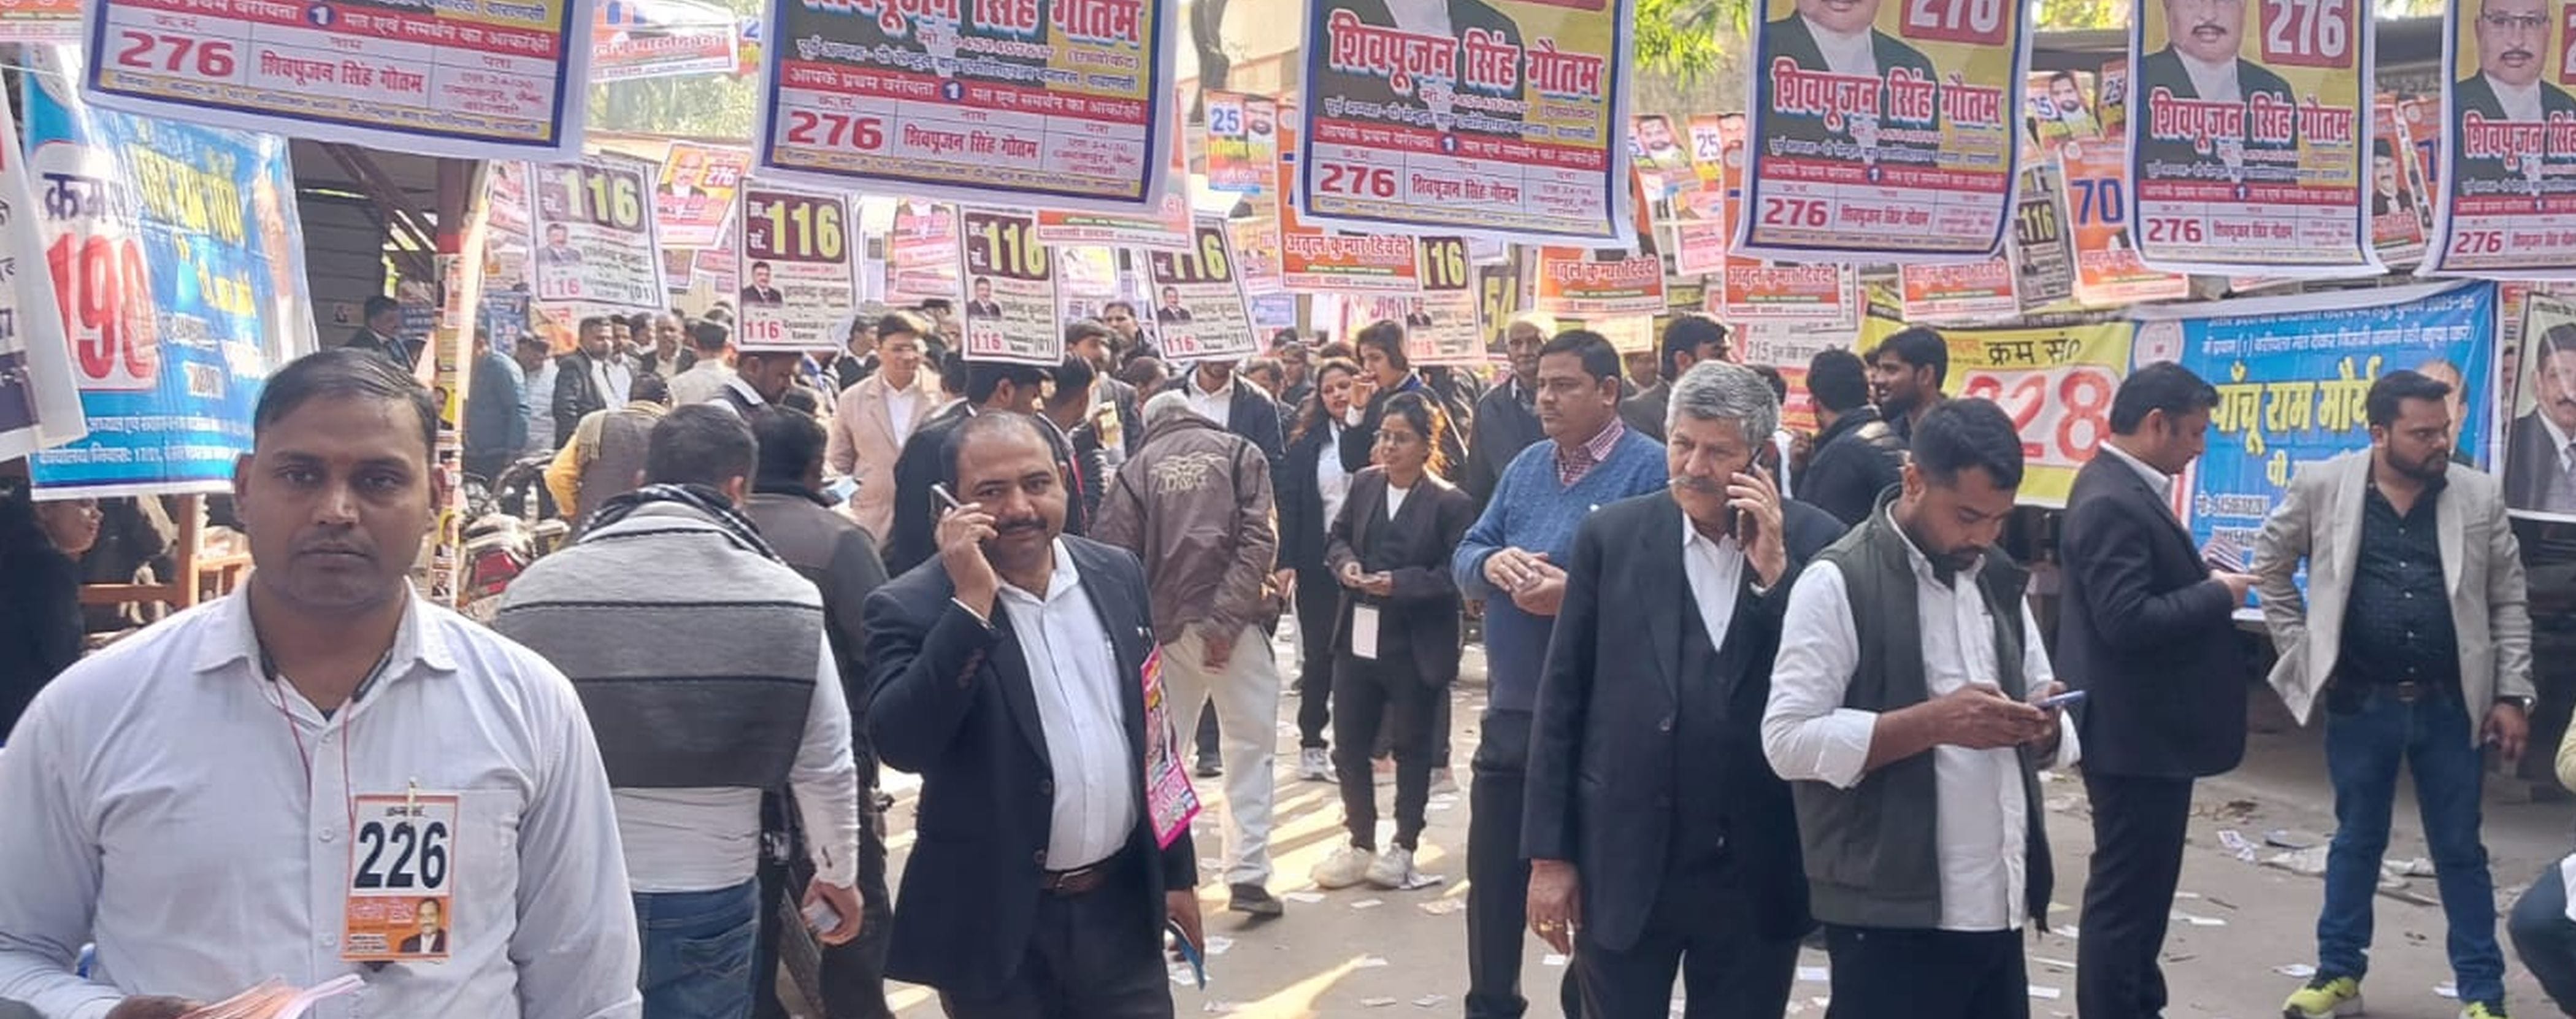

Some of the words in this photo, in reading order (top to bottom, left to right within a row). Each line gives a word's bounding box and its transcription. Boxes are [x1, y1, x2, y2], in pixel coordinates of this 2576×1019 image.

[314, 7, 328, 24] 1
[345, 13, 368, 27] मत
[403, 19, 456, 39] समर्थन
[460, 27, 483, 42] का
[2269, 0, 2346, 58] 276
[118, 31, 234, 77] 276
[261, 50, 334, 85] शिवपूजन
[342, 61, 372, 87] सिंह
[381, 66, 424, 93] गौतम
[1328, 10, 1458, 93] शिवपूजन
[1464, 29, 1519, 88] सिंह
[1526, 38, 1603, 96] गौतम
[791, 66, 837, 85] आपके
[842, 72, 879, 88] प्रथम
[883, 74, 935, 96] वरीयता
[946, 83, 959, 99] 1
[972, 87, 991, 101] मत
[996, 88, 1018, 106] एवं
[1021, 91, 1063, 110] समर्थन
[1066, 98, 1086, 112] का
[1772, 57, 1883, 131] शिवपूजन
[1887, 66, 1934, 121] सिंह
[1940, 73, 2004, 124] गौतम
[788, 110, 883, 150] 276
[1211, 107, 1240, 132] 25
[1319, 123, 1358, 139] आपके
[1360, 129, 1390, 144] प्रथम
[1444, 136, 1454, 150] 1
[2150, 87, 2246, 155] शिवपूजन
[2250, 91, 2296, 140] सिंह
[2298, 94, 2354, 142] गौतम
[904, 123, 965, 155] शिवपूजन
[970, 129, 995, 154] सिंह
[1001, 134, 1038, 159] गौतम
[1696, 133, 1720, 158] 25
[2463, 110, 2546, 171] शिवपूजन
[1320, 163, 1396, 198] 276
[1412, 174, 1460, 199] शिवपूजन
[1465, 179, 1485, 199] सिंह
[1490, 182, 1519, 203] गौतम
[1871, 168, 1879, 181] 1
[2237, 186, 2245, 199] 1
[561, 169, 640, 227] 116
[1764, 198, 1827, 227] 276
[2071, 179, 2125, 225] 70
[765, 200, 841, 258] 116
[2020, 203, 2055, 242] 116
[2147, 218, 2202, 243] 276
[982, 221, 1046, 275] 116
[2454, 231, 2503, 254] 276
[1420, 241, 1466, 286] 116
[542, 278, 580, 296] 116
[745, 320, 779, 339] 116
[1484, 277, 1517, 345] 54
[972, 333, 1002, 350] 116
[1983, 339, 2036, 366] क्रम
[2266, 380, 2315, 433] राम
[353, 821, 448, 889] 226
